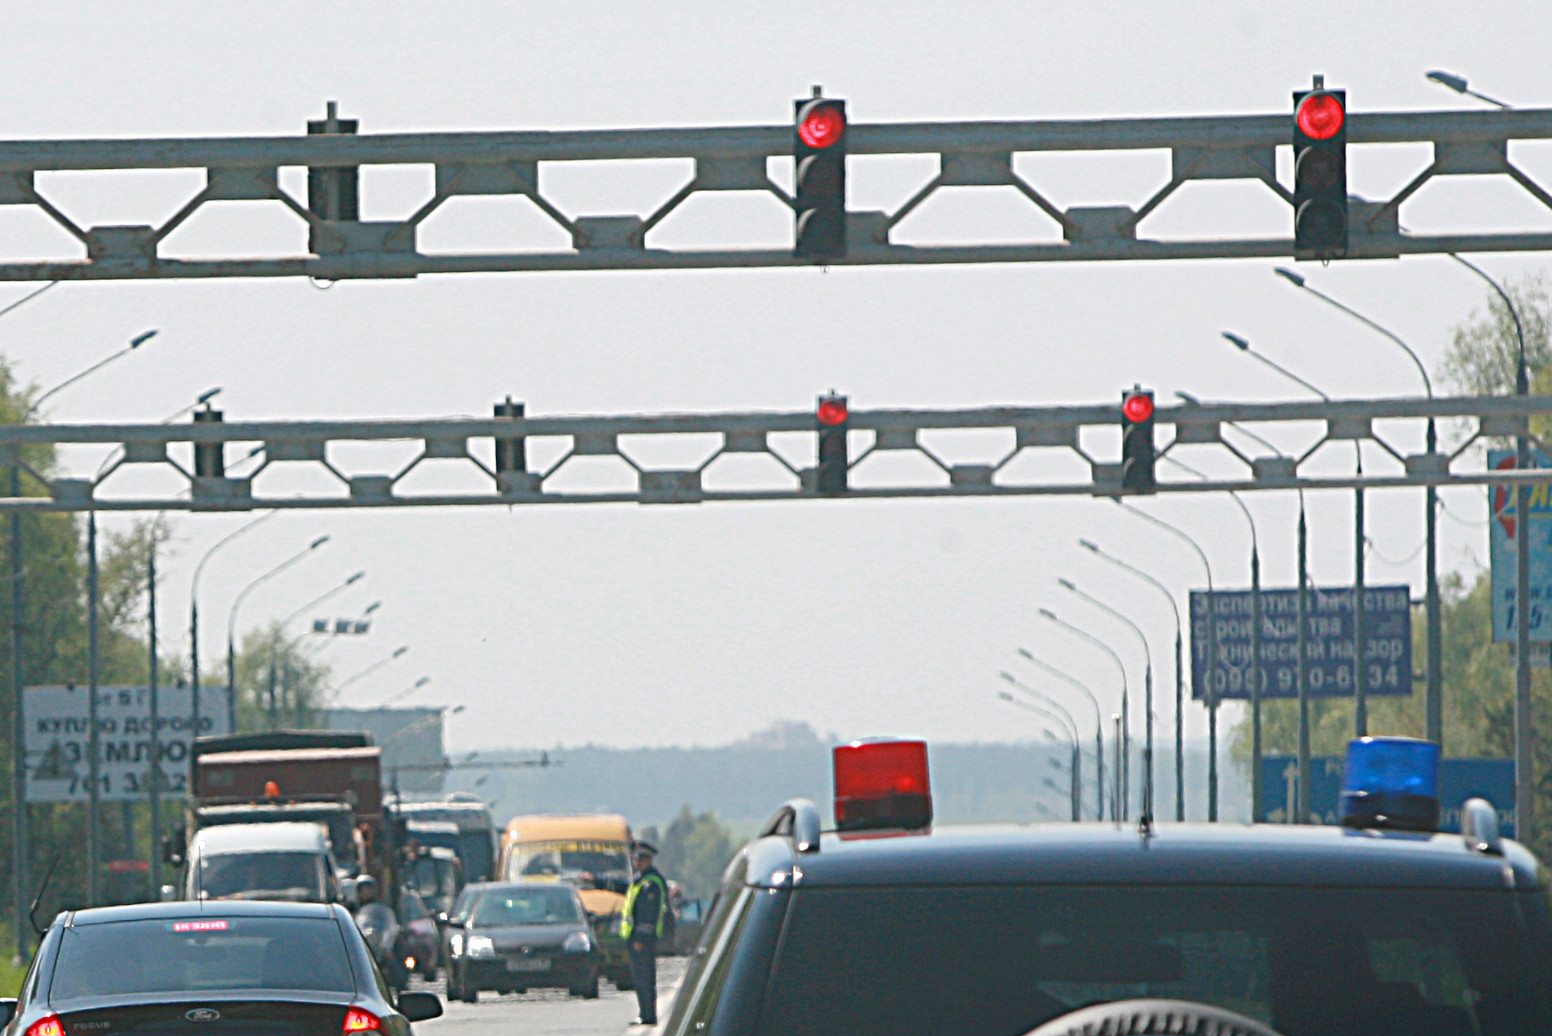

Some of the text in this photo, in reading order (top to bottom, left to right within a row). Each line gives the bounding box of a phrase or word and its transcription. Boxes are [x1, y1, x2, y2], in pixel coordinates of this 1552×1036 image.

[1330, 638, 1404, 661] назор
[1277, 664, 1398, 692] 90-634
[63, 739, 188, 763] ЗМЛЮ
